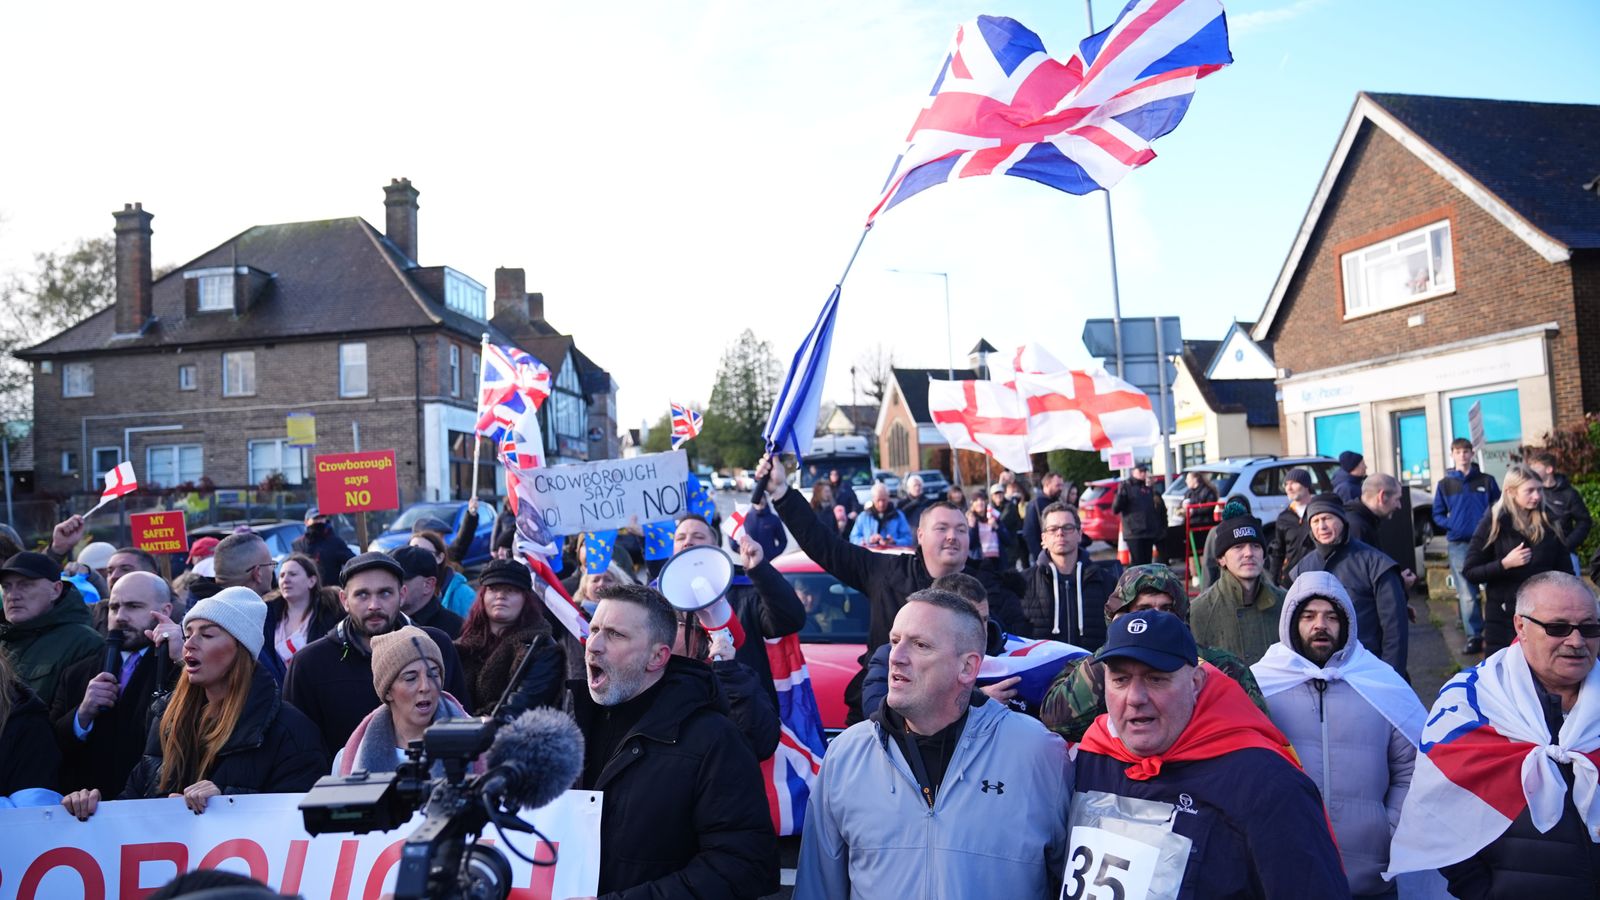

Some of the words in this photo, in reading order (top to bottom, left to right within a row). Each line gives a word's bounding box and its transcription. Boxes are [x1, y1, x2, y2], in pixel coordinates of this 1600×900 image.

[318, 456, 392, 473] Crowborough
[344, 474, 369, 487] says
[534, 463, 657, 493] CROWBOROUGH
[344, 490, 371, 507] NO
[585, 483, 625, 501] SAYS
[580, 498, 625, 525] NO!!
[150, 516, 165, 526] MY
[143, 527, 175, 539] SAFETY
[140, 539, 181, 551] MATTERS
[1062, 845, 1131, 900] 35
